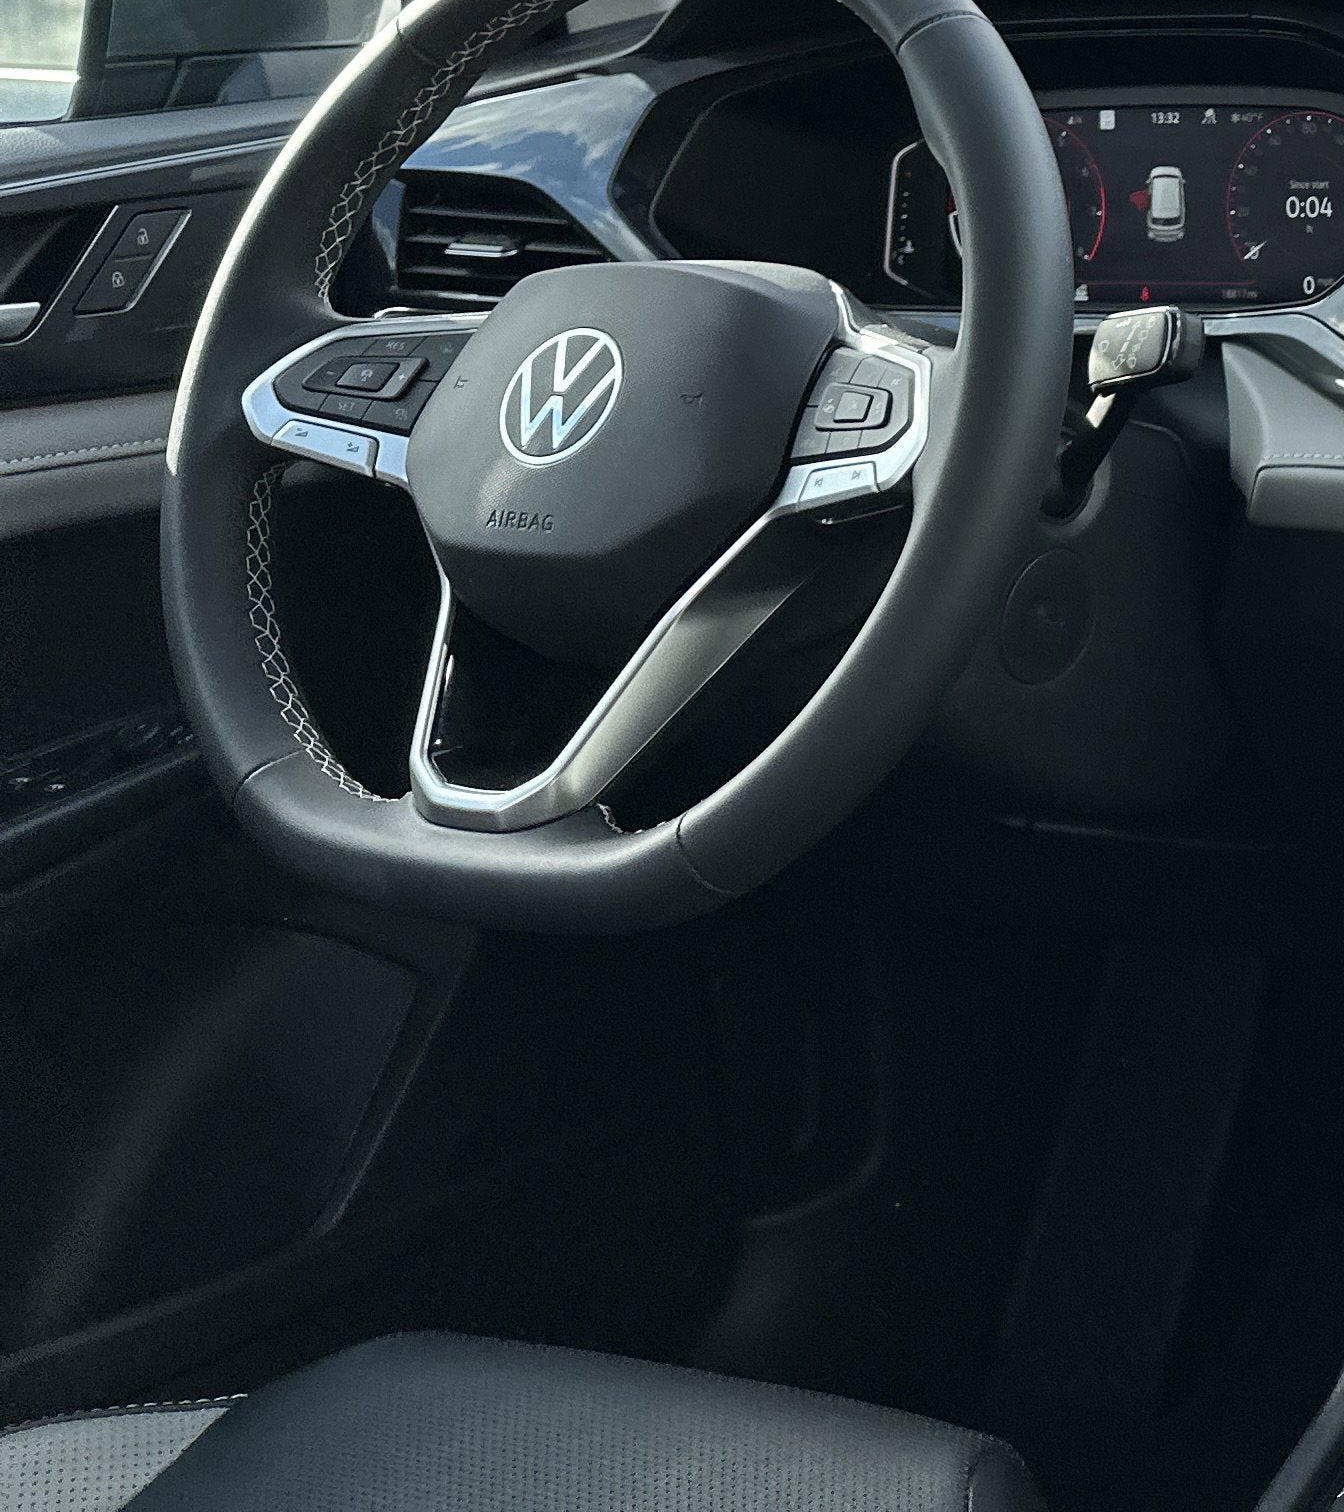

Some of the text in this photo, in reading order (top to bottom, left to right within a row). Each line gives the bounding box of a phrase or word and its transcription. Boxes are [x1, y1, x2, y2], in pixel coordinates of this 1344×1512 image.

[1151, 112, 1181, 124] 13:32
[1285, 196, 1333, 218] 0:04
[485, 509, 555, 533] AIRBAG
